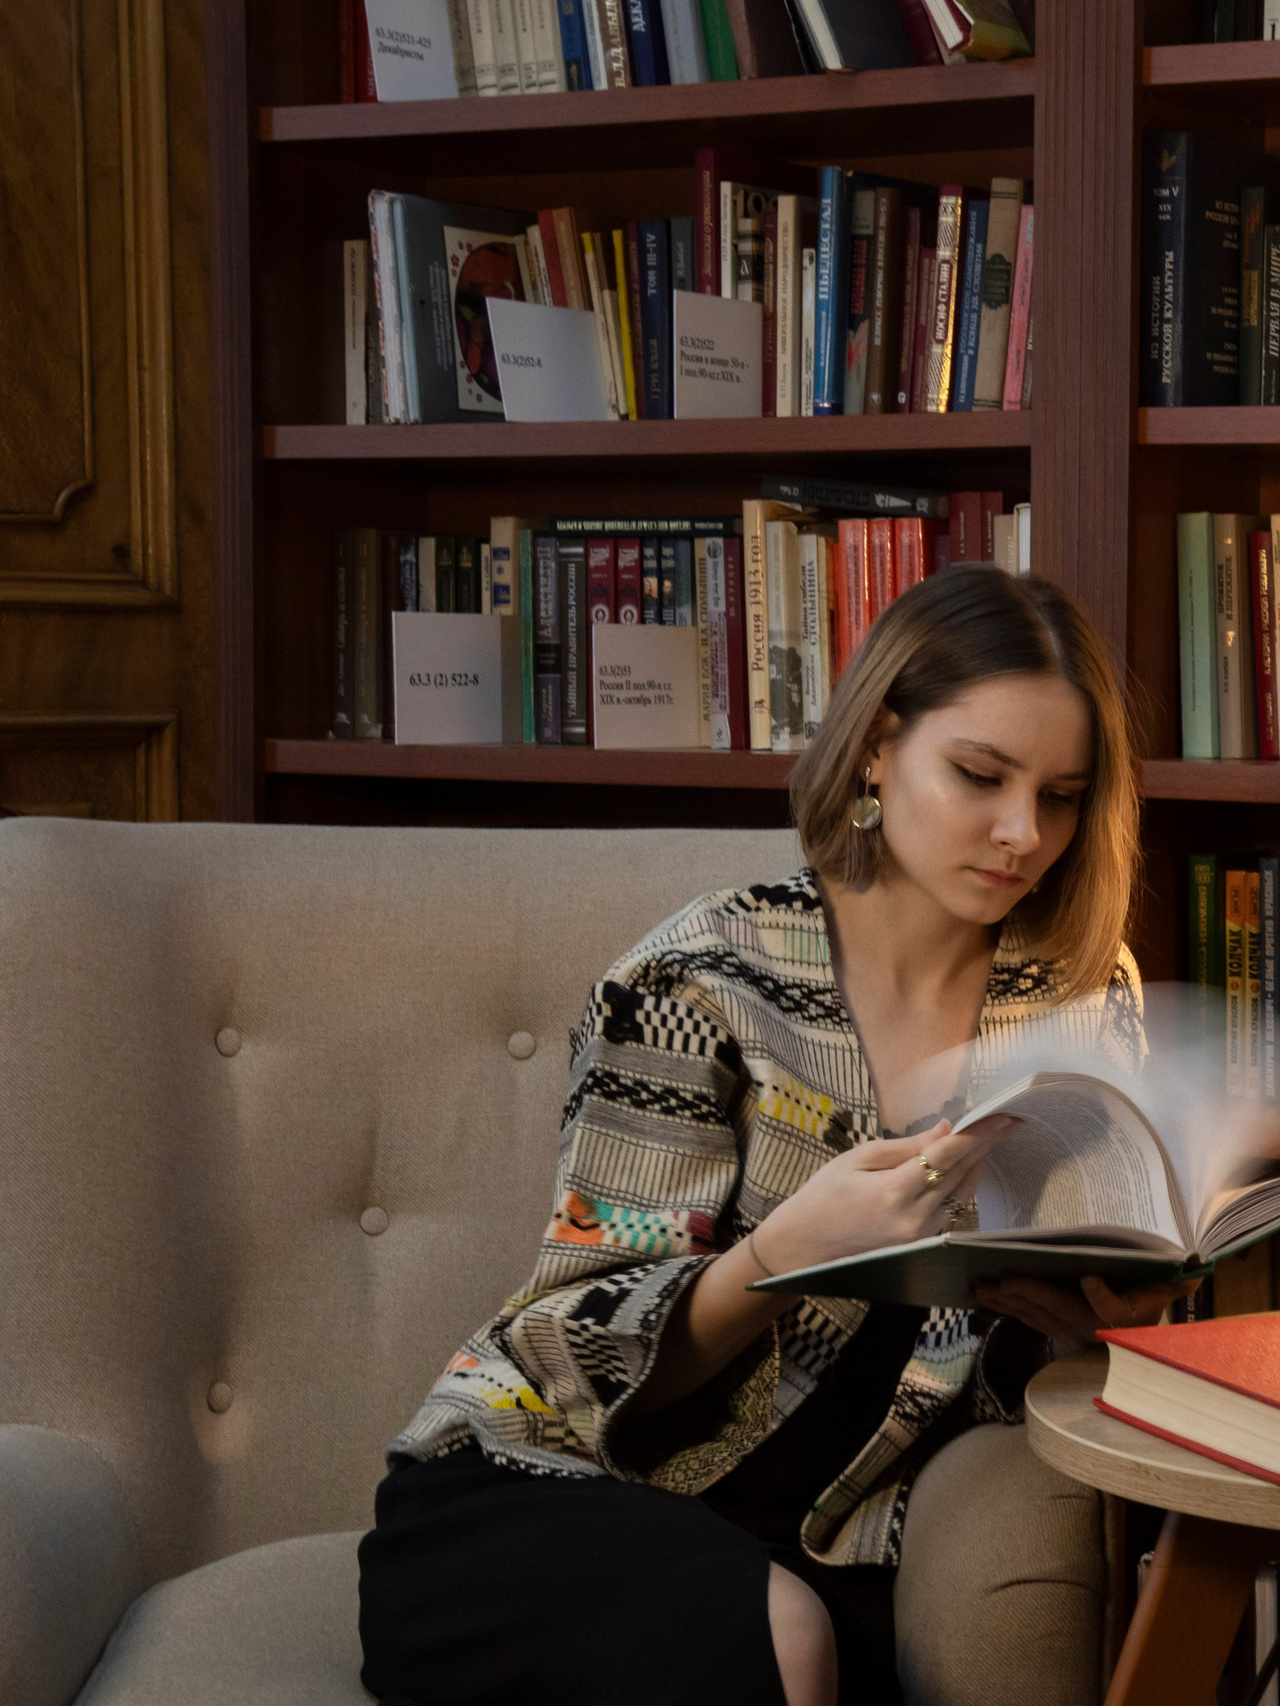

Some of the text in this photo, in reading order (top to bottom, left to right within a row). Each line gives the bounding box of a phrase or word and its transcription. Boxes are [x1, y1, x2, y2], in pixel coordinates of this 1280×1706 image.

[378, 41, 424, 61] Декабристы
[818, 197, 832, 300] ПЬЕДЕСТАЛ
[1270, 243, 1280, 283] МИРЕ
[935, 262, 951, 340] ИОСИФ СТАЛИН
[1150, 275, 1161, 359] ИЗ ИСТОРИИ
[1161, 250, 1174, 384] РУССКОЙ КУЛЬТУРЫ
[680, 335, 715, 352] 63.3(2)522
[1269, 301, 1280, 357] ПЕРВАЯ
[680, 350, 729, 367] Россия конце
[749, 534, 766, 671] Россия 1913 год
[807, 559, 818, 646] СТОЛЫПИНА
[567, 562, 579, 718] ТАЙНЫЙ ПРАВИТЕЛЬ РОССИИ
[409, 672, 479, 689] 63.3 (2) 522-8
[599, 665, 631, 677] 63.3(2)53
[599, 679, 624, 691] Россия
[599, 694, 614, 705] XIX
[1228, 929, 1243, 978] КОЛЧАК
[1248, 930, 1260, 979] КОЛЧАК
